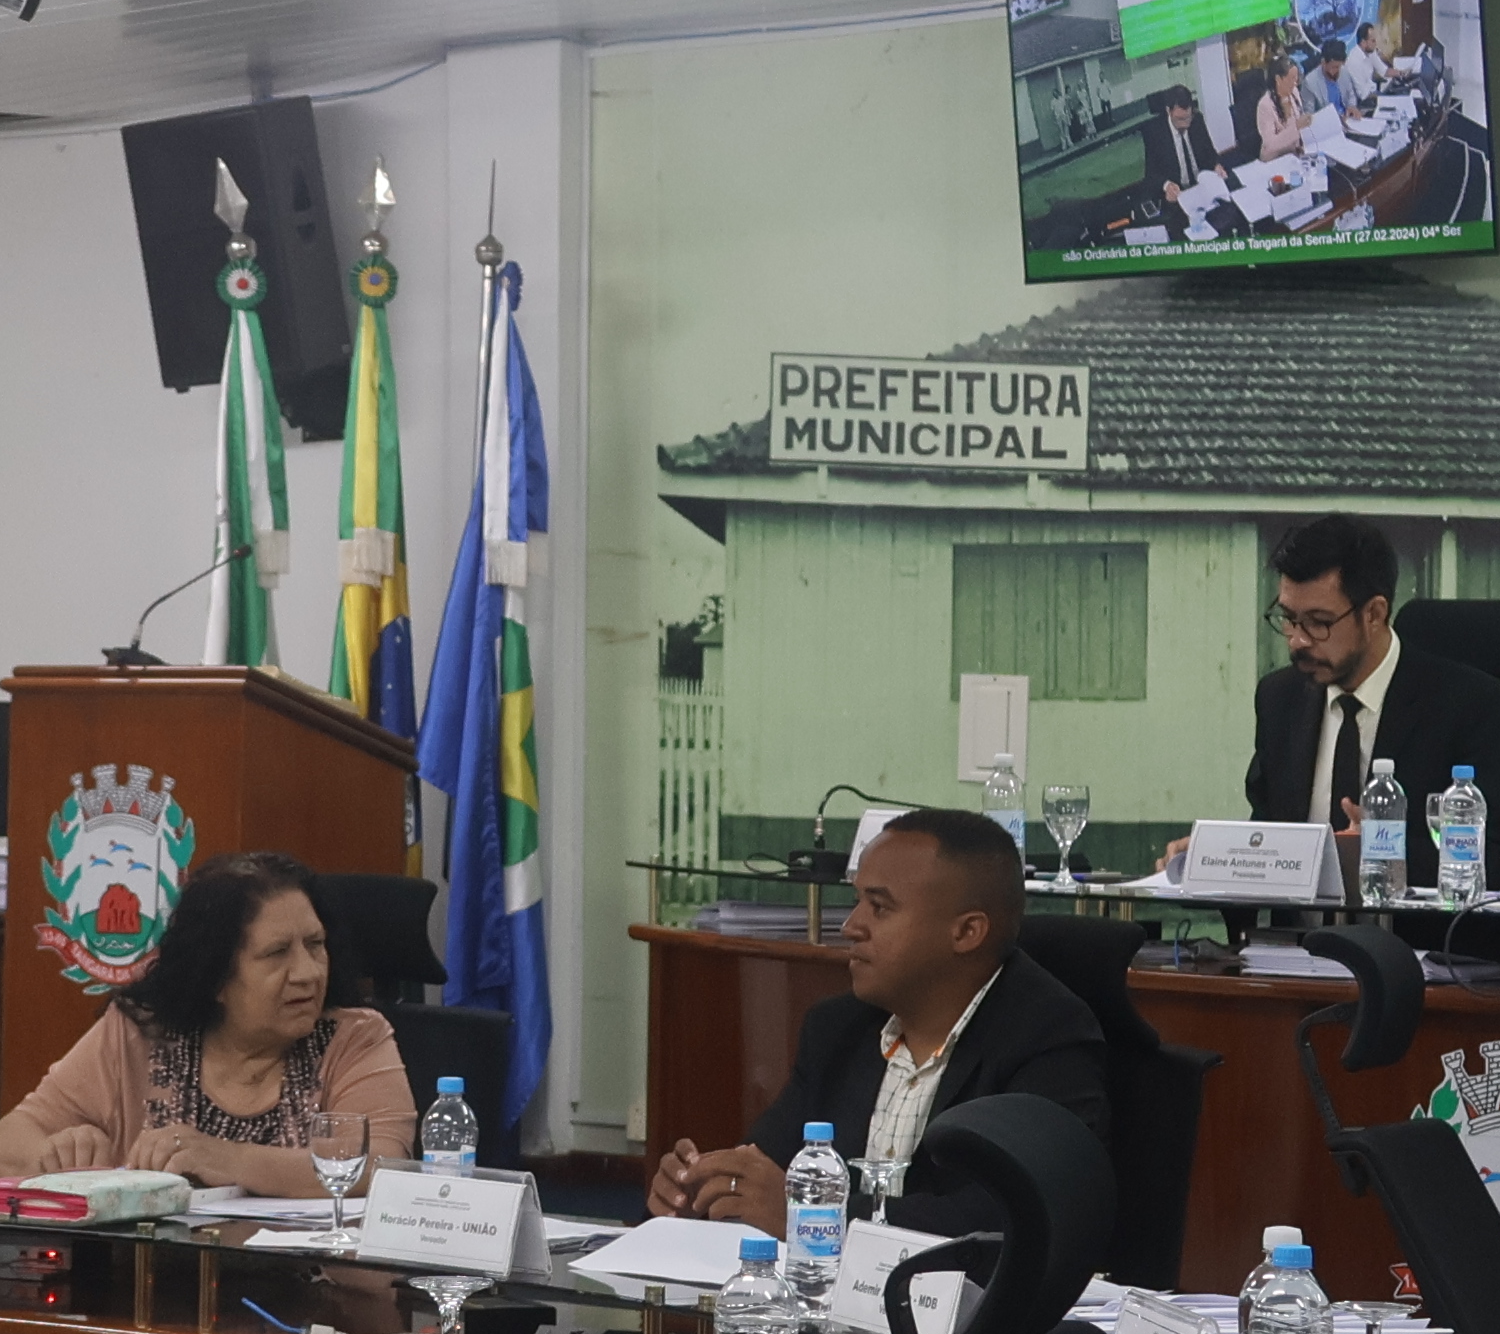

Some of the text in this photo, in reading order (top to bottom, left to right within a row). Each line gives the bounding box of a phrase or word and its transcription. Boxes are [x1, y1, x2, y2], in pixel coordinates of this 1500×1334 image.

[1084, 247, 1128, 262] Ordinária
[1130, 246, 1142, 258] da
[1143, 242, 1183, 257] Câmara
[1184, 239, 1230, 256] Municipal
[1232, 238, 1246, 250] de
[1247, 235, 1287, 253] Tangará
[1289, 235, 1303, 247] da
[1305, 231, 1352, 247] Serra-MT
[1354, 229, 1420, 245] (27.02.2024)
[778, 362, 1082, 419] PREFEITURA
[783, 416, 1069, 462] MUNICIPAL
[1201, 856, 1228, 867] Elaine
[1230, 857, 1266, 869] Antunes
[1274, 860, 1302, 871] PODE
[379, 1211, 417, 1227] Horácio
[418, 1217, 454, 1231] Pereira
[462, 1219, 498, 1236] UNIÃO
[797, 1224, 841, 1236] BRUNADO
[852, 1279, 882, 1297] Ademir
[918, 1294, 939, 1310] MDB
